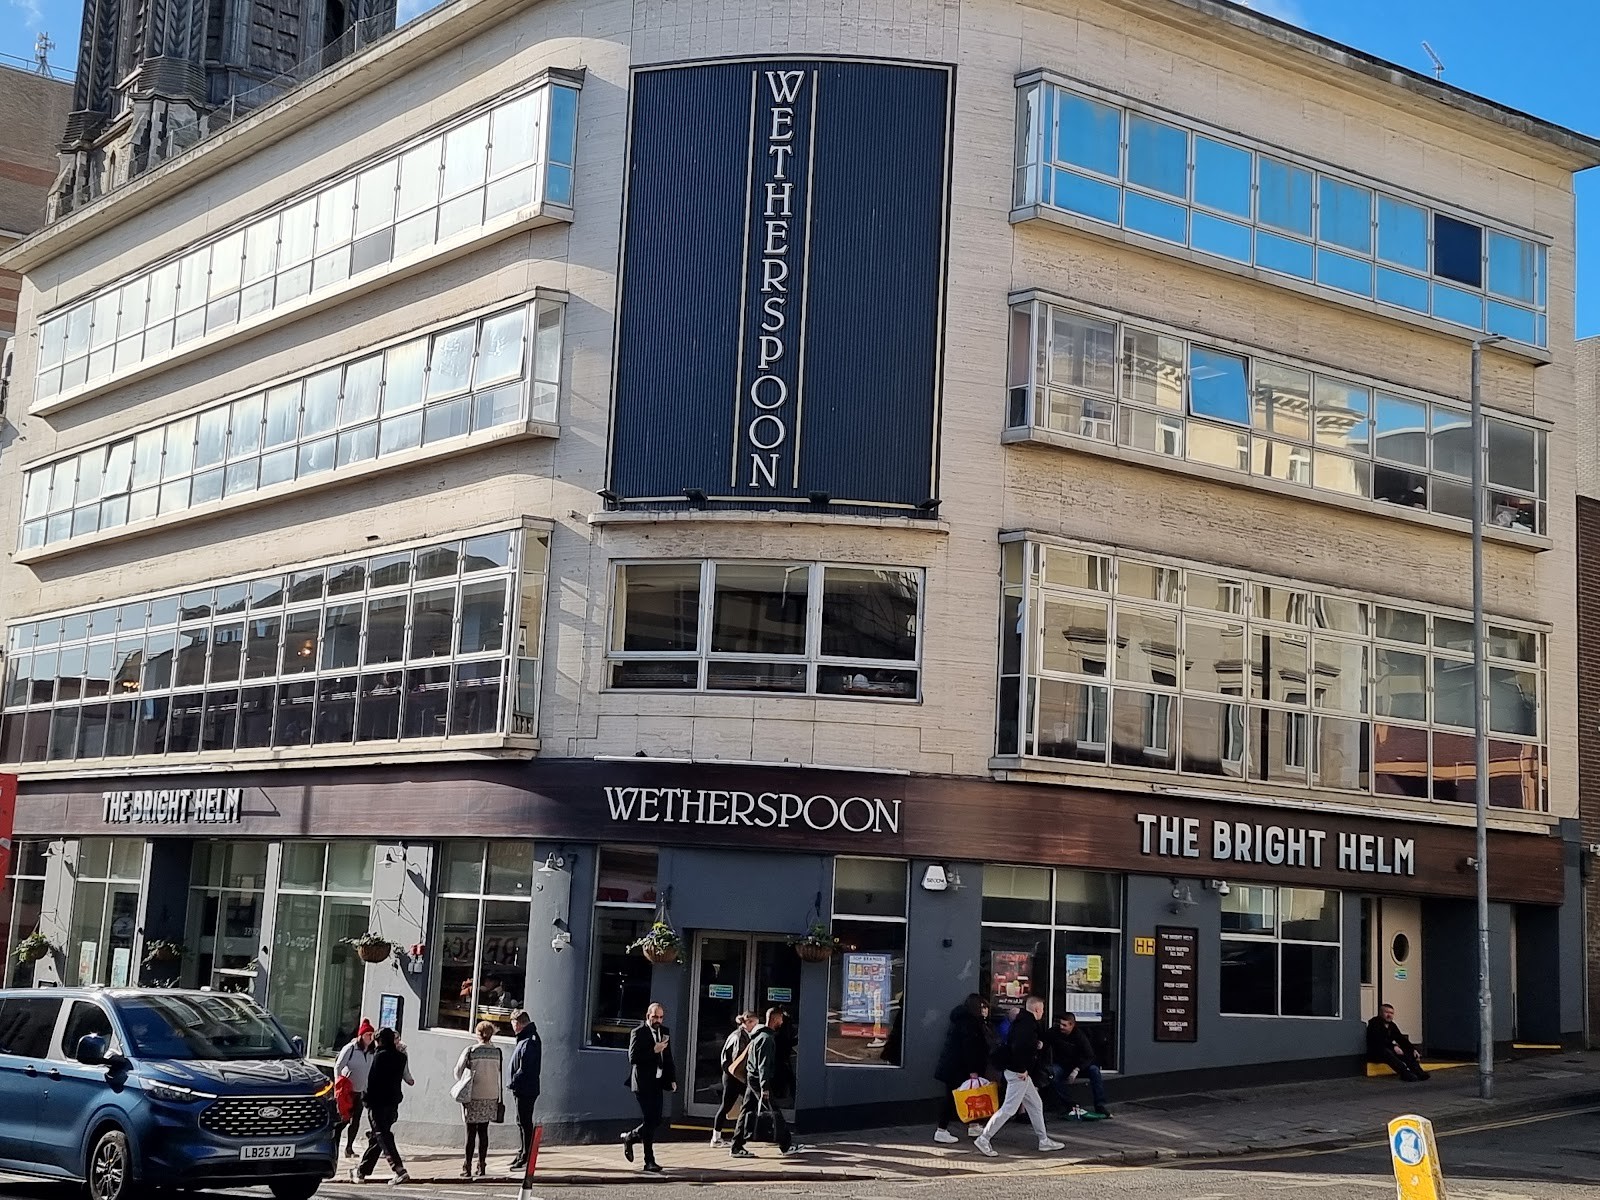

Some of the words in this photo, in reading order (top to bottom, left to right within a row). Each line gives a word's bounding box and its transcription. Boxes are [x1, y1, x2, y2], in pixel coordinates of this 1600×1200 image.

[749, 70, 805, 487] WETHERSPOON
[102, 791, 131, 822] THE
[132, 789, 192, 822] BRIGHT
[194, 788, 242, 821] HELM
[603, 786, 901, 834] WETHERSPOON
[1136, 813, 1200, 858] THE
[1212, 820, 1326, 868] BRIGHT
[1338, 832, 1415, 876] HELM
[245, 1147, 271, 1158] LB25
[273, 1146, 291, 1157] XJZ
